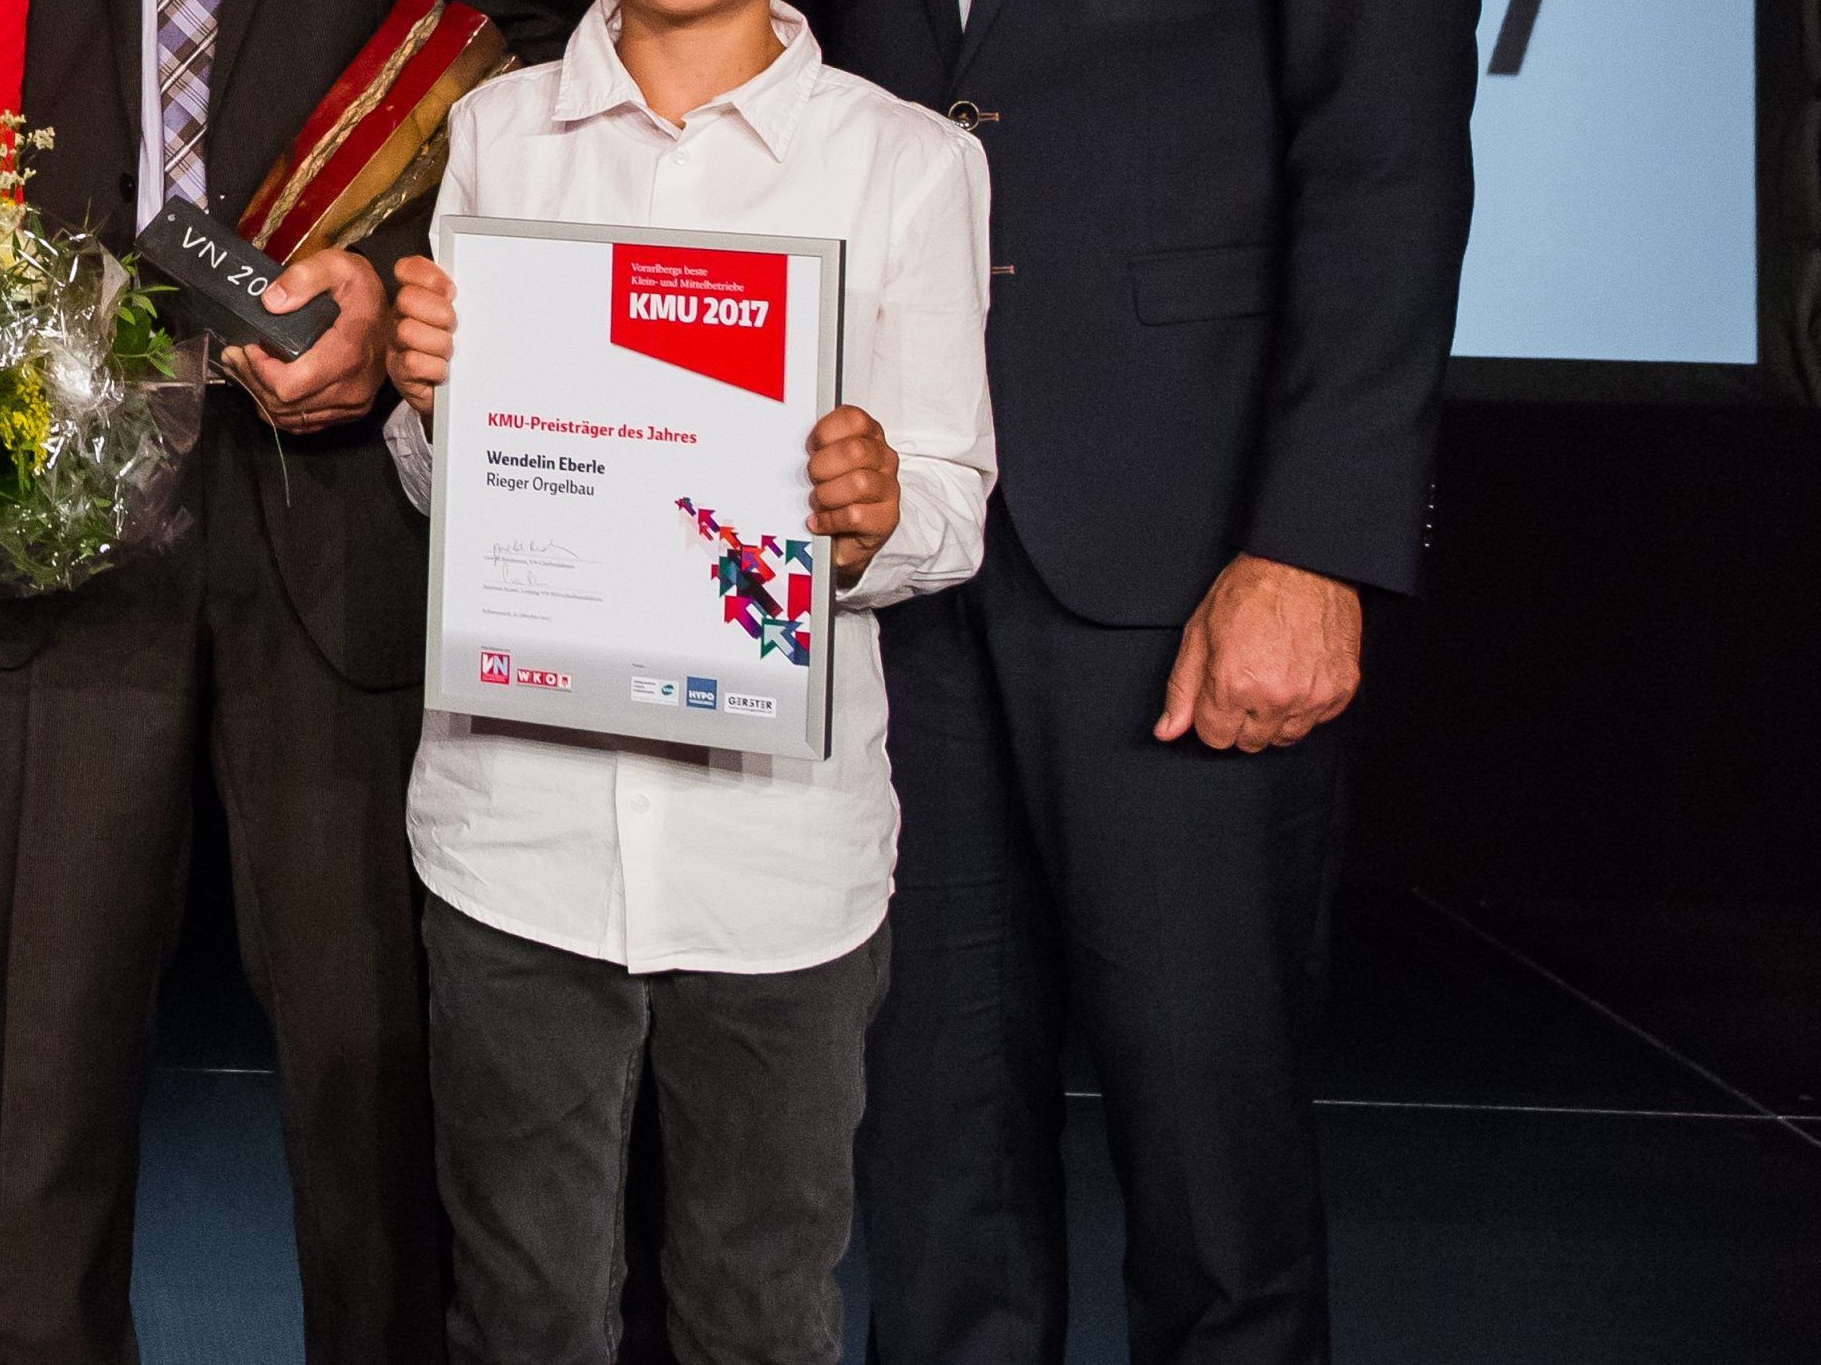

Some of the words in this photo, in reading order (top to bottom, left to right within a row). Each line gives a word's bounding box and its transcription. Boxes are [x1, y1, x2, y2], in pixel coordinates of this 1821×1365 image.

[181, 226, 228, 269] VN
[631, 263, 682, 277] Vorarlbergs
[684, 266, 708, 276] beste
[631, 276, 659, 287] Klein-
[660, 279, 678, 288] und
[680, 279, 745, 292] Mittelbetriebe
[629, 292, 698, 323] KMU
[702, 297, 769, 328] 2017
[488, 412, 615, 439] KMU-Preisträger
[618, 424, 643, 439] des
[647, 426, 698, 444] Jahres
[487, 450, 555, 470] Wendelin
[559, 457, 605, 474] Eberle
[486, 472, 530, 491] Rieger
[532, 477, 595, 496] Orgelbau
[482, 653, 508, 676] VN
[728, 696, 773, 710] GERSTER
